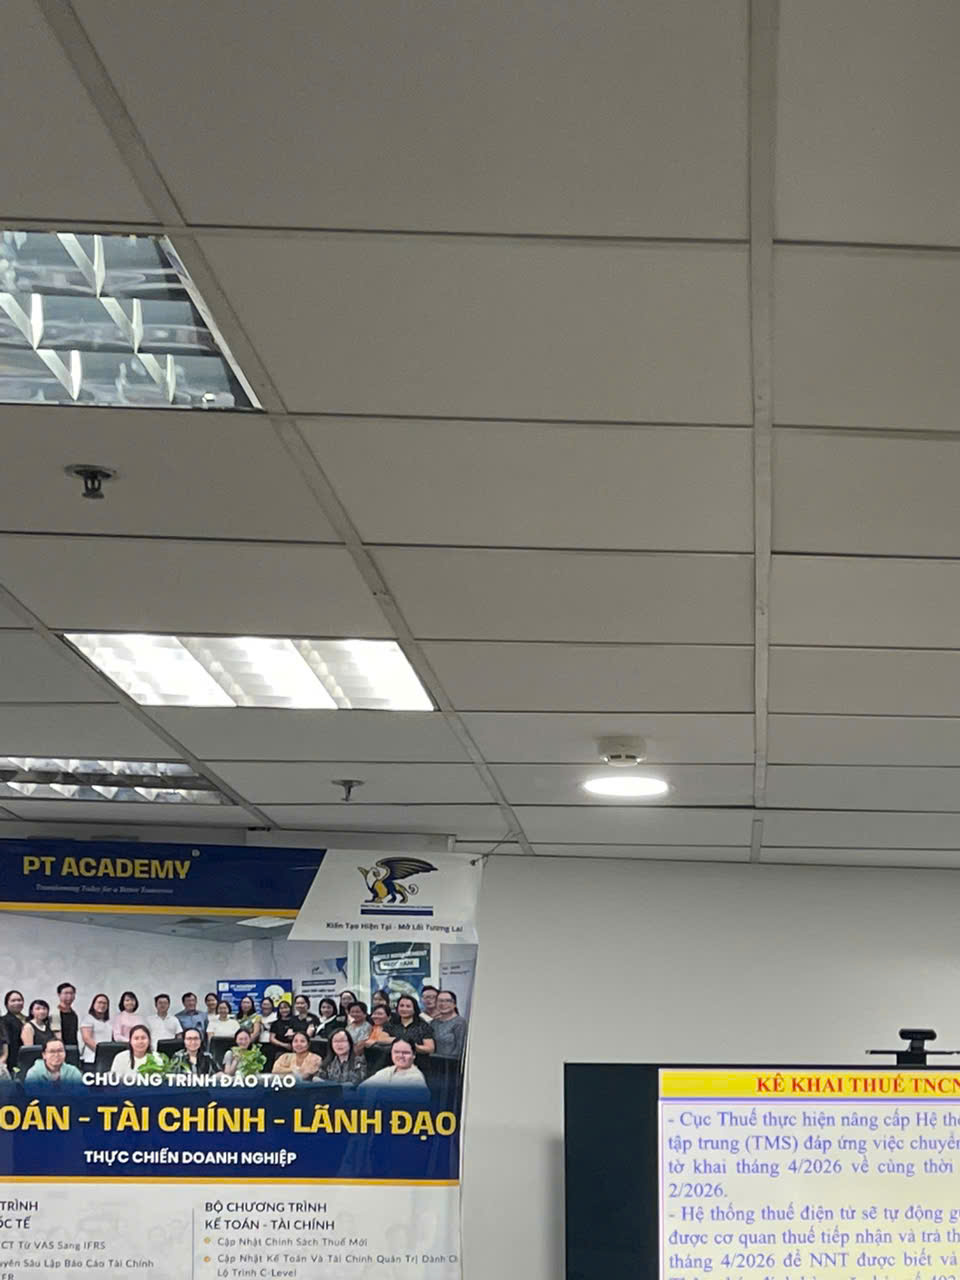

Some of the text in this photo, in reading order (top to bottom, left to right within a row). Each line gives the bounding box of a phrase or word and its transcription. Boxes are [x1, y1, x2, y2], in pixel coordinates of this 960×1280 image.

[24, 856, 191, 879] PT ACADEMY
[262, 1074, 296, 1091] TẠO
[758, 1073, 784, 1093] KÊ
[792, 1078, 842, 1092] KHAI
[849, 1075, 904, 1092] THUẾ
[97, 1100, 149, 1131] TÀI
[158, 1101, 265, 1132] CHÍNH
[294, 1104, 382, 1134] LÃNH
[389, 1110, 457, 1140] ĐẠO
[680, 1112, 711, 1129] Cục
[717, 1107, 757, 1126] Thuế
[763, 1112, 797, 1129] thực
[802, 1112, 835, 1129] hiện
[841, 1112, 878, 1131] nâng
[883, 1108, 910, 1131] cấp
[916, 1112, 937, 1129] Hệ
[668, 1135, 692, 1154] tập
[698, 1137, 740, 1154] trung
[745, 1136, 798, 1153] (TMS)
[803, 1135, 832, 1154] đáp
[838, 1136, 867, 1154] ứng
[873, 1136, 904, 1152] việc
[84, 1147, 296, 1167] THỰC CHIẾN DOANH NGHIỆP
[668, 1159, 685, 1174] tờ
[693, 1158, 726, 1174] khai
[736, 1158, 780, 1178] tháng
[788, 1158, 842, 1174] 4/2026
[924, 1158, 953, 1173] thời
[669, 1182, 727, 1198] 2/2026.
[205, 1200, 326, 1214] BỘ CHƯƠNG TRÌNH
[681, 1206, 704, 1223] Hệ
[710, 1202, 755, 1224] thống
[761, 1202, 794, 1220] thuế
[800, 1205, 833, 1223] điện
[884, 1208, 899, 1222] tự
[904, 1205, 943, 1223] động
[15, 1216, 31, 1229] TẾ
[205, 1216, 334, 1230] KẾ TOÁN TÀI CHÍNH
[668, 1230, 708, 1248] được
[714, 1234, 733, 1245] cơ
[738, 1233, 776, 1249] quan
[782, 1224, 815, 1244] thuế
[821, 1224, 850, 1248] tiếp
[856, 1228, 892, 1246] nhận
